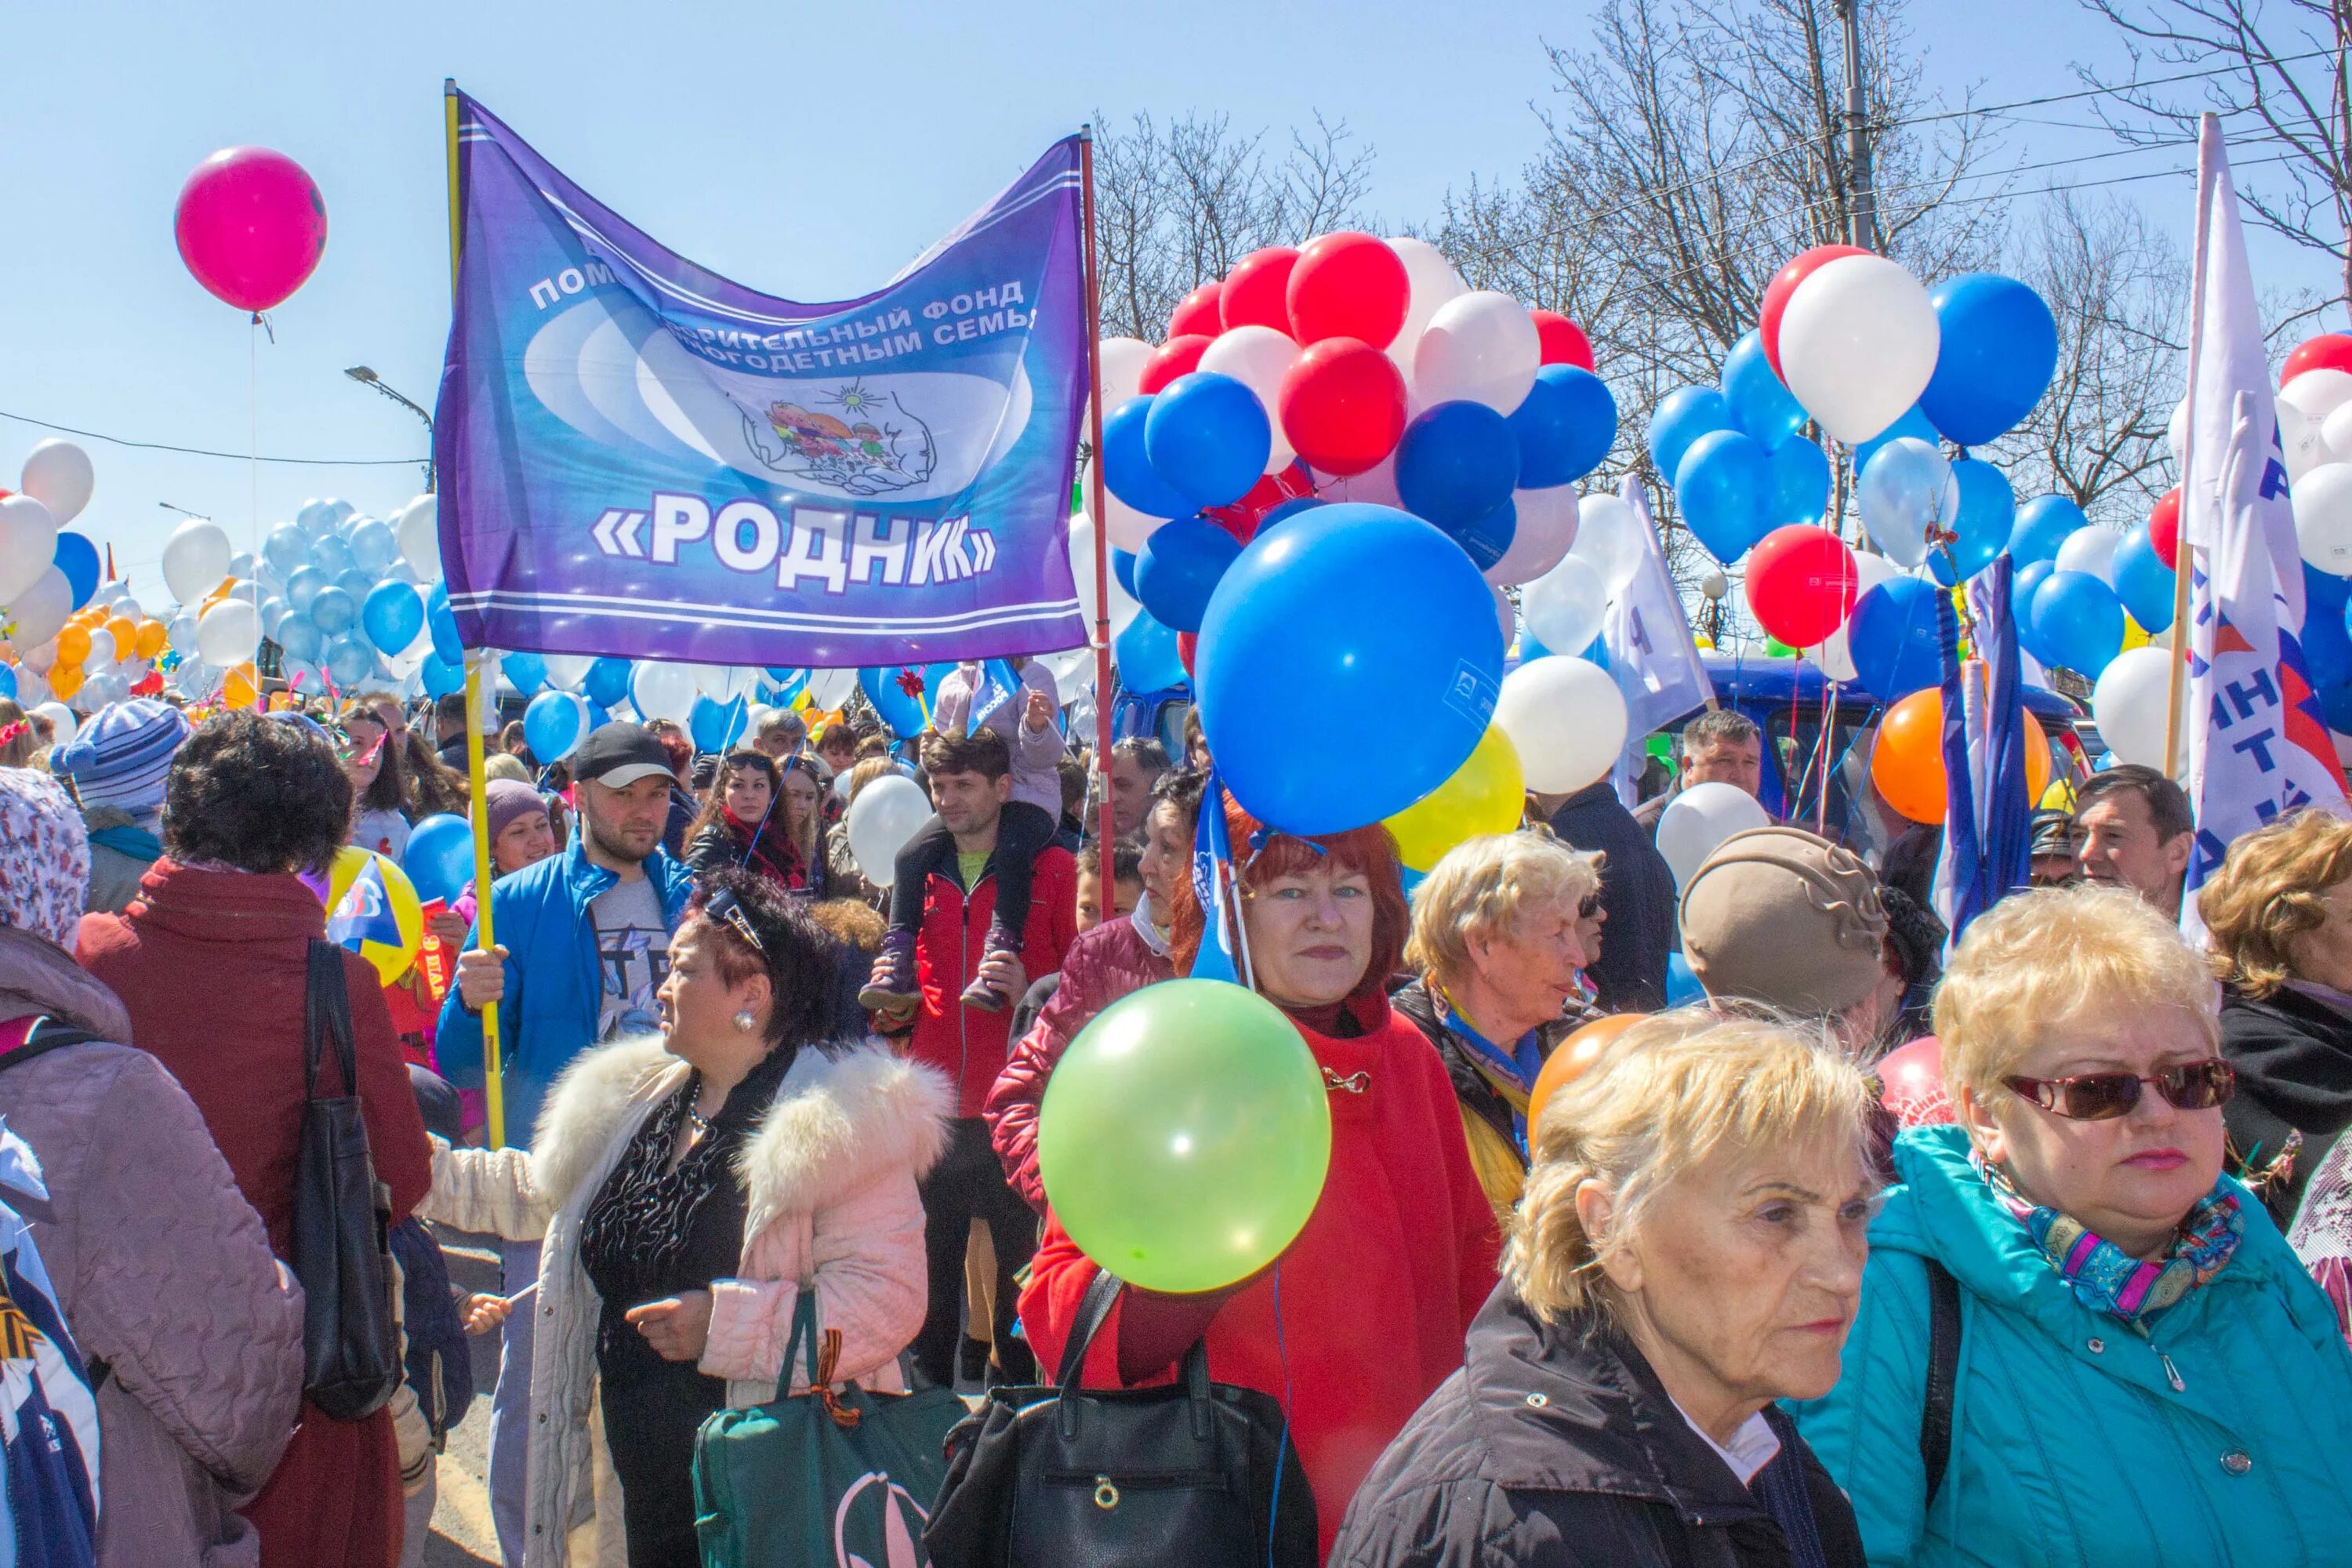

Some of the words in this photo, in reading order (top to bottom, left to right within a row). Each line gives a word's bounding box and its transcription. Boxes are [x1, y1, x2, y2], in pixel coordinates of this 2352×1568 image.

[528, 263, 615, 310] ПОМ
[933, 308, 1037, 345] СЕМЬ
[923, 281, 1024, 320] ФОНД
[590, 492, 996, 594] «РОДНИК»
